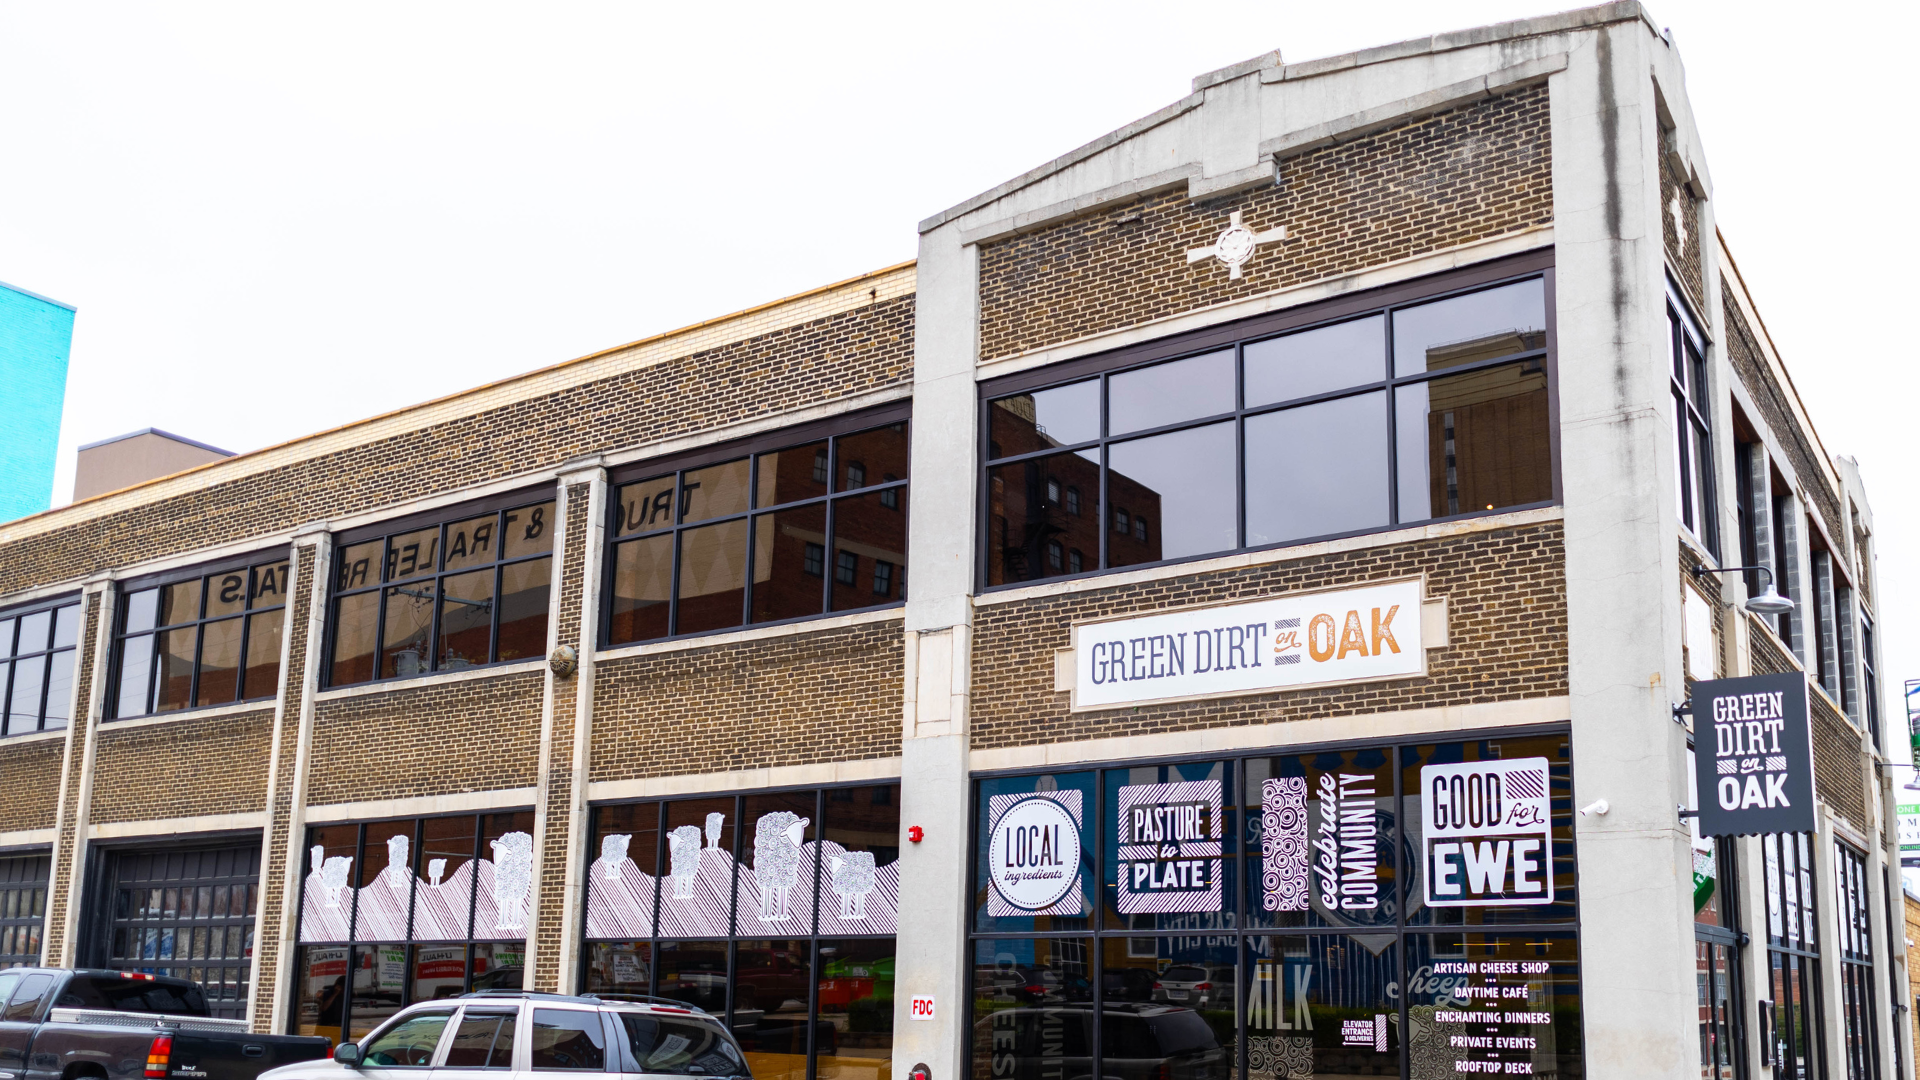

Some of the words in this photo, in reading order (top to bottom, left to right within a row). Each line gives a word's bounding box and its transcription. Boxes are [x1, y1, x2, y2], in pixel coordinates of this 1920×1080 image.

[1092, 632, 1187, 685] GREEN
[1193, 622, 1267, 674] DIRT
[1274, 629, 1302, 652] on
[1308, 605, 1401, 663] OAK
[1713, 692, 1783, 723] GREEN
[1715, 719, 1784, 757] DIRT
[1740, 757, 1764, 774] on
[1718, 773, 1790, 811] OAK
[1432, 772, 1502, 830] GOOD
[1505, 802, 1545, 828] for
[1897, 806, 1916, 814] ONE
[1134, 805, 1204, 842] PASTURE
[1005, 824, 1063, 868] LOCAL
[1312, 772, 1338, 910] celebrate
[1339, 773, 1378, 910] COMMUNITY
[1160, 843, 1180, 859] to
[1134, 860, 1204, 889] PLATE
[1434, 839, 1542, 895] EWE
[1004, 869, 1064, 886] ingredients
[1433, 962, 1477, 974] ARTISAN
[1480, 962, 1518, 974] CHEESE
[1521, 962, 1549, 974] SHOP
[1455, 986, 1500, 999] DAYTIME
[1503, 984, 1528, 999] CAFÉ
[912, 999, 933, 1016] FDC
[1343, 1020, 1374, 1028] ELEVATOR
[1435, 1011, 1502, 1023] ENCHANTING
[1504, 1011, 1551, 1024] DINNERS
[1341, 1028, 1374, 1036] ENTRANCE
[1450, 1036, 1492, 1048] PRIVATE
[1496, 1036, 1536, 1049] EVENTS
[1455, 1060, 1501, 1073] ROOFTOP
[1504, 1061, 1532, 1074] DECK
